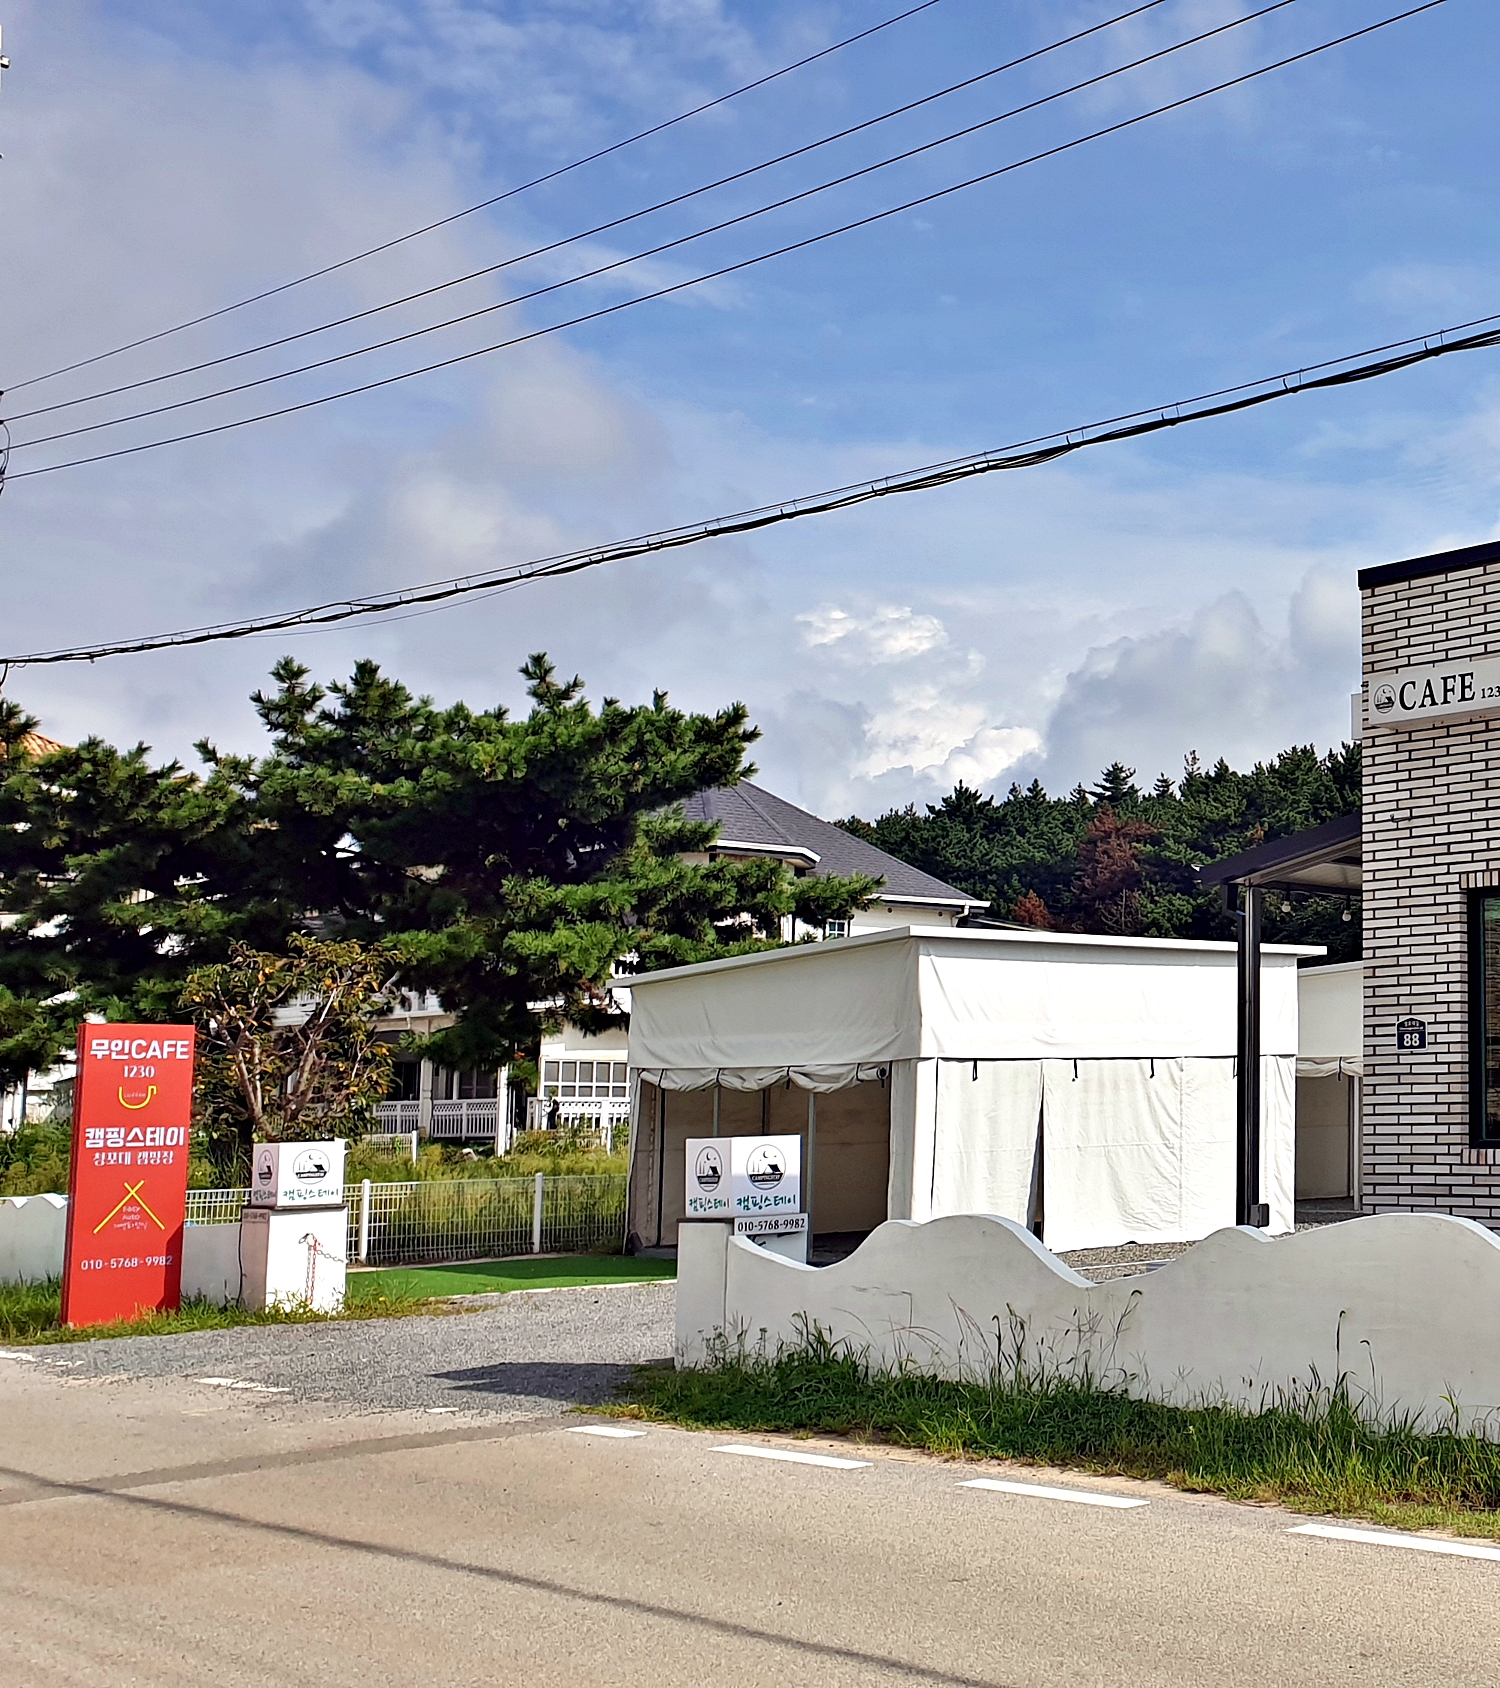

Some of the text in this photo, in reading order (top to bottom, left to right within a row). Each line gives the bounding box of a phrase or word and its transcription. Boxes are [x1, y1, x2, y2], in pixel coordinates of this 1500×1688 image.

[1399, 671, 1476, 711] CAFE
[1403, 1033, 1420, 1047] 88
[90, 1039, 190, 1060] 무인CAFE
[123, 1065, 156, 1078] 1230
[85, 1127, 185, 1148] 캠핑스테이
[283, 1188, 339, 1201] 캠핑스테이
[689, 1197, 730, 1212] 캠핑스테이
[736, 1194, 796, 1211] 캠핑스테이
[737, 1218, 806, 1232] 010-5768-9982
